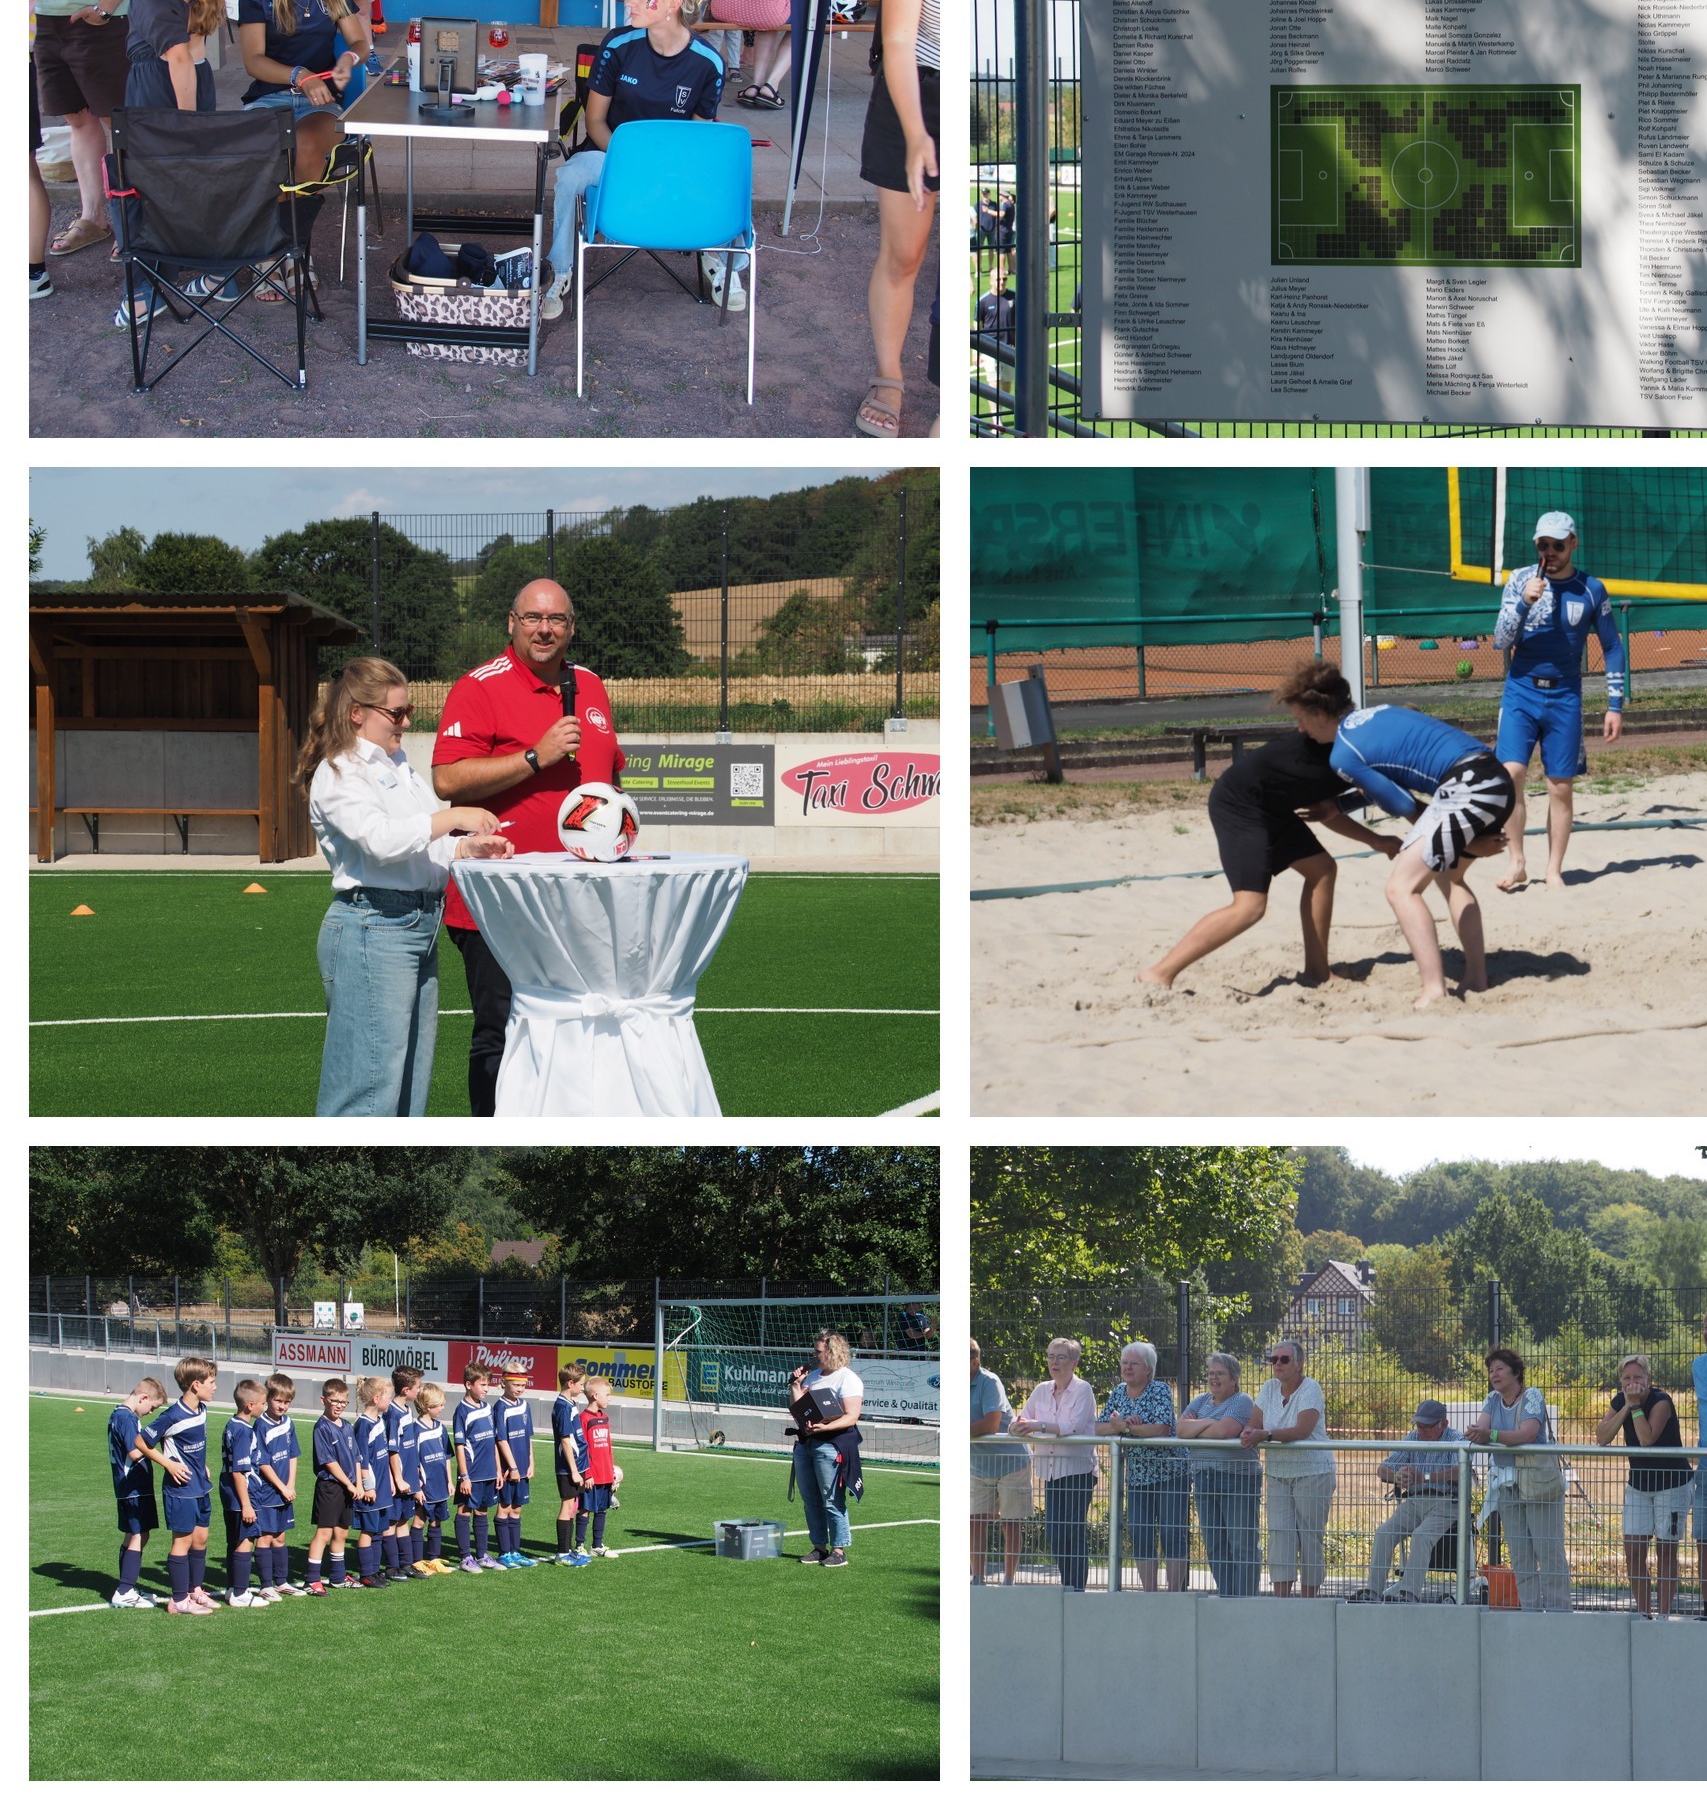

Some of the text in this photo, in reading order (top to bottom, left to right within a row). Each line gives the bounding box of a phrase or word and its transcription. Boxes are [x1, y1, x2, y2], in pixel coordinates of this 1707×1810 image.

[619, 74, 638, 85] JAKO
[658, 754, 715, 769] Mirage
[816, 754, 879, 768] Mein Lieblingstaxi!
[631, 779, 654, 788] Catering
[666, 779, 711, 787] Streetfood Events
[797, 770, 849, 816] Taxi
[278, 1343, 439, 1371] ASSMANN BÜROMÖBEL
[891, 1398, 938, 1412] & Qualität
